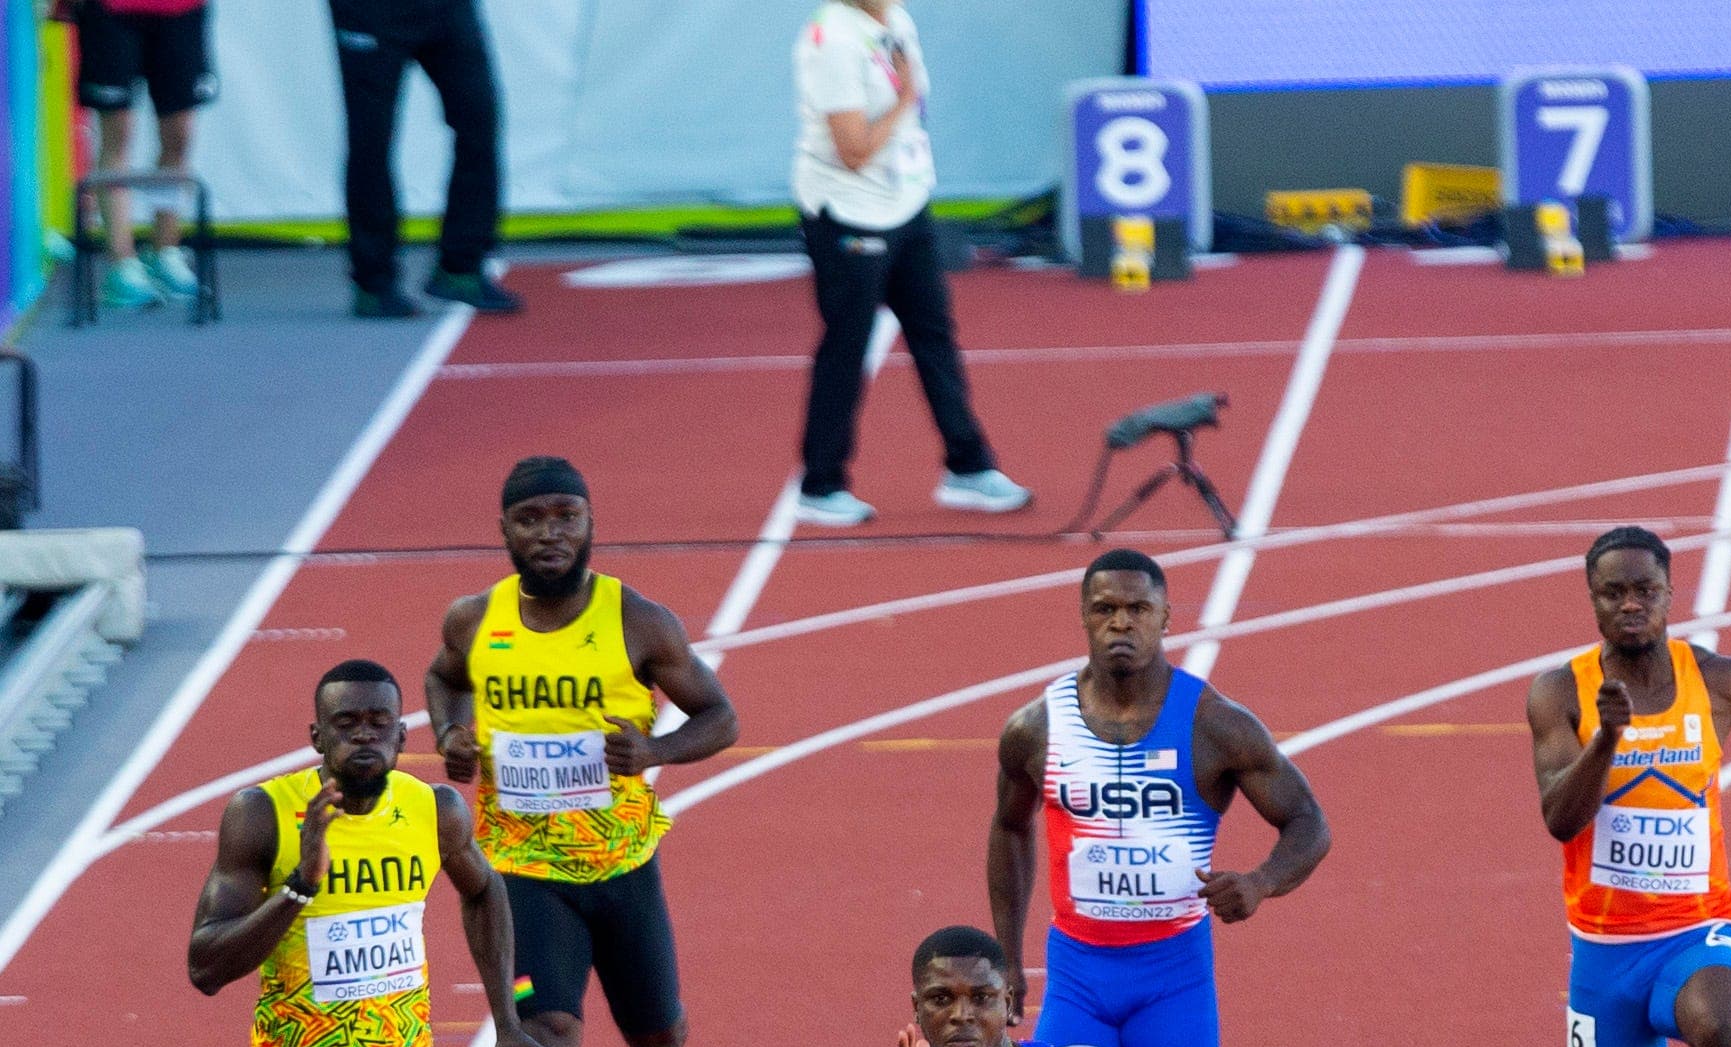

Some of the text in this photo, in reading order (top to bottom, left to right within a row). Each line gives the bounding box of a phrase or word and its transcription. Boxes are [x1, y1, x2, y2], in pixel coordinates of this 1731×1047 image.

[1096, 116, 1171, 208] 8
[1536, 106, 1610, 196] 7
[485, 675, 605, 710] GHANA
[524, 739, 587, 759] TDK
[1611, 745, 1701, 767] ederland
[502, 762, 604, 789] ODURO MANU
[515, 796, 592, 810] OREGON22
[1060, 780, 1181, 820] USA
[1633, 815, 1695, 836] TDK
[1107, 844, 1173, 866] TDK
[1609, 839, 1695, 870] BOUJU
[328, 855, 426, 895] HANA
[1098, 871, 1165, 896] HALL
[1609, 874, 1692, 891] OREGON22
[1091, 904, 1173, 919] OREGON22
[347, 911, 409, 939] TDK
[325, 937, 416, 976] AMOAH
[335, 975, 414, 999] OREGON22
